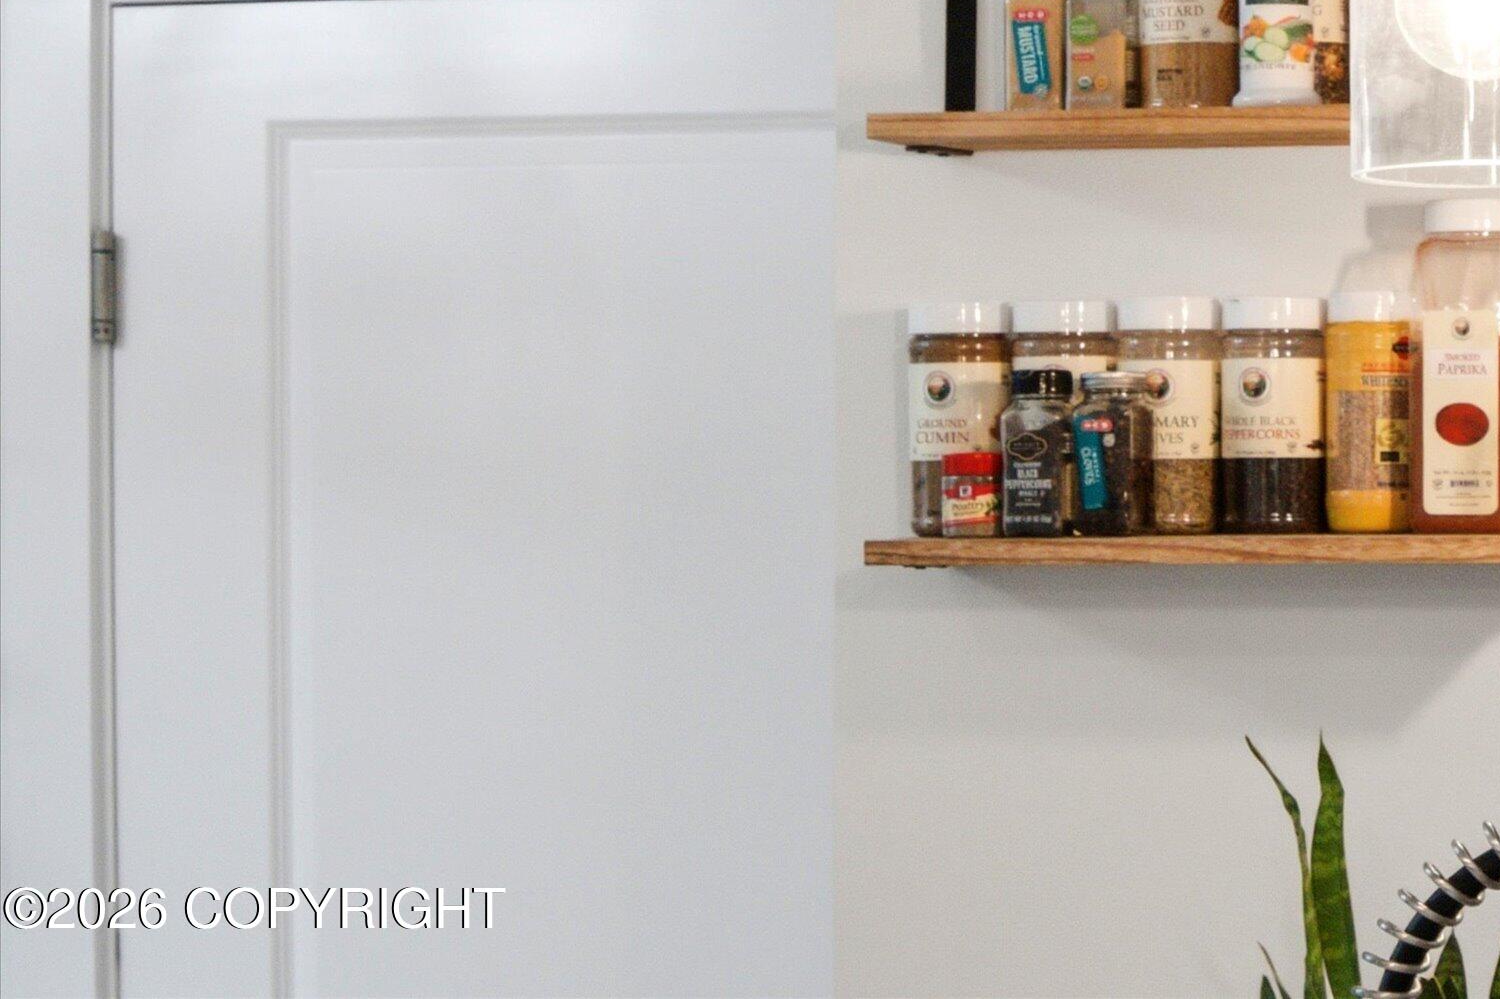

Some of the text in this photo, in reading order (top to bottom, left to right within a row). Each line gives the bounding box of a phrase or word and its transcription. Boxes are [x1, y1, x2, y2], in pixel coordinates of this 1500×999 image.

[1142, 4, 1204, 18] MUSTARD
[1154, 20, 1185, 31] SEED
[1018, 25, 1039, 83] MUSTARD
[1437, 363, 1488, 375] PAPRIKA
[916, 431, 969, 443] CUMIN
